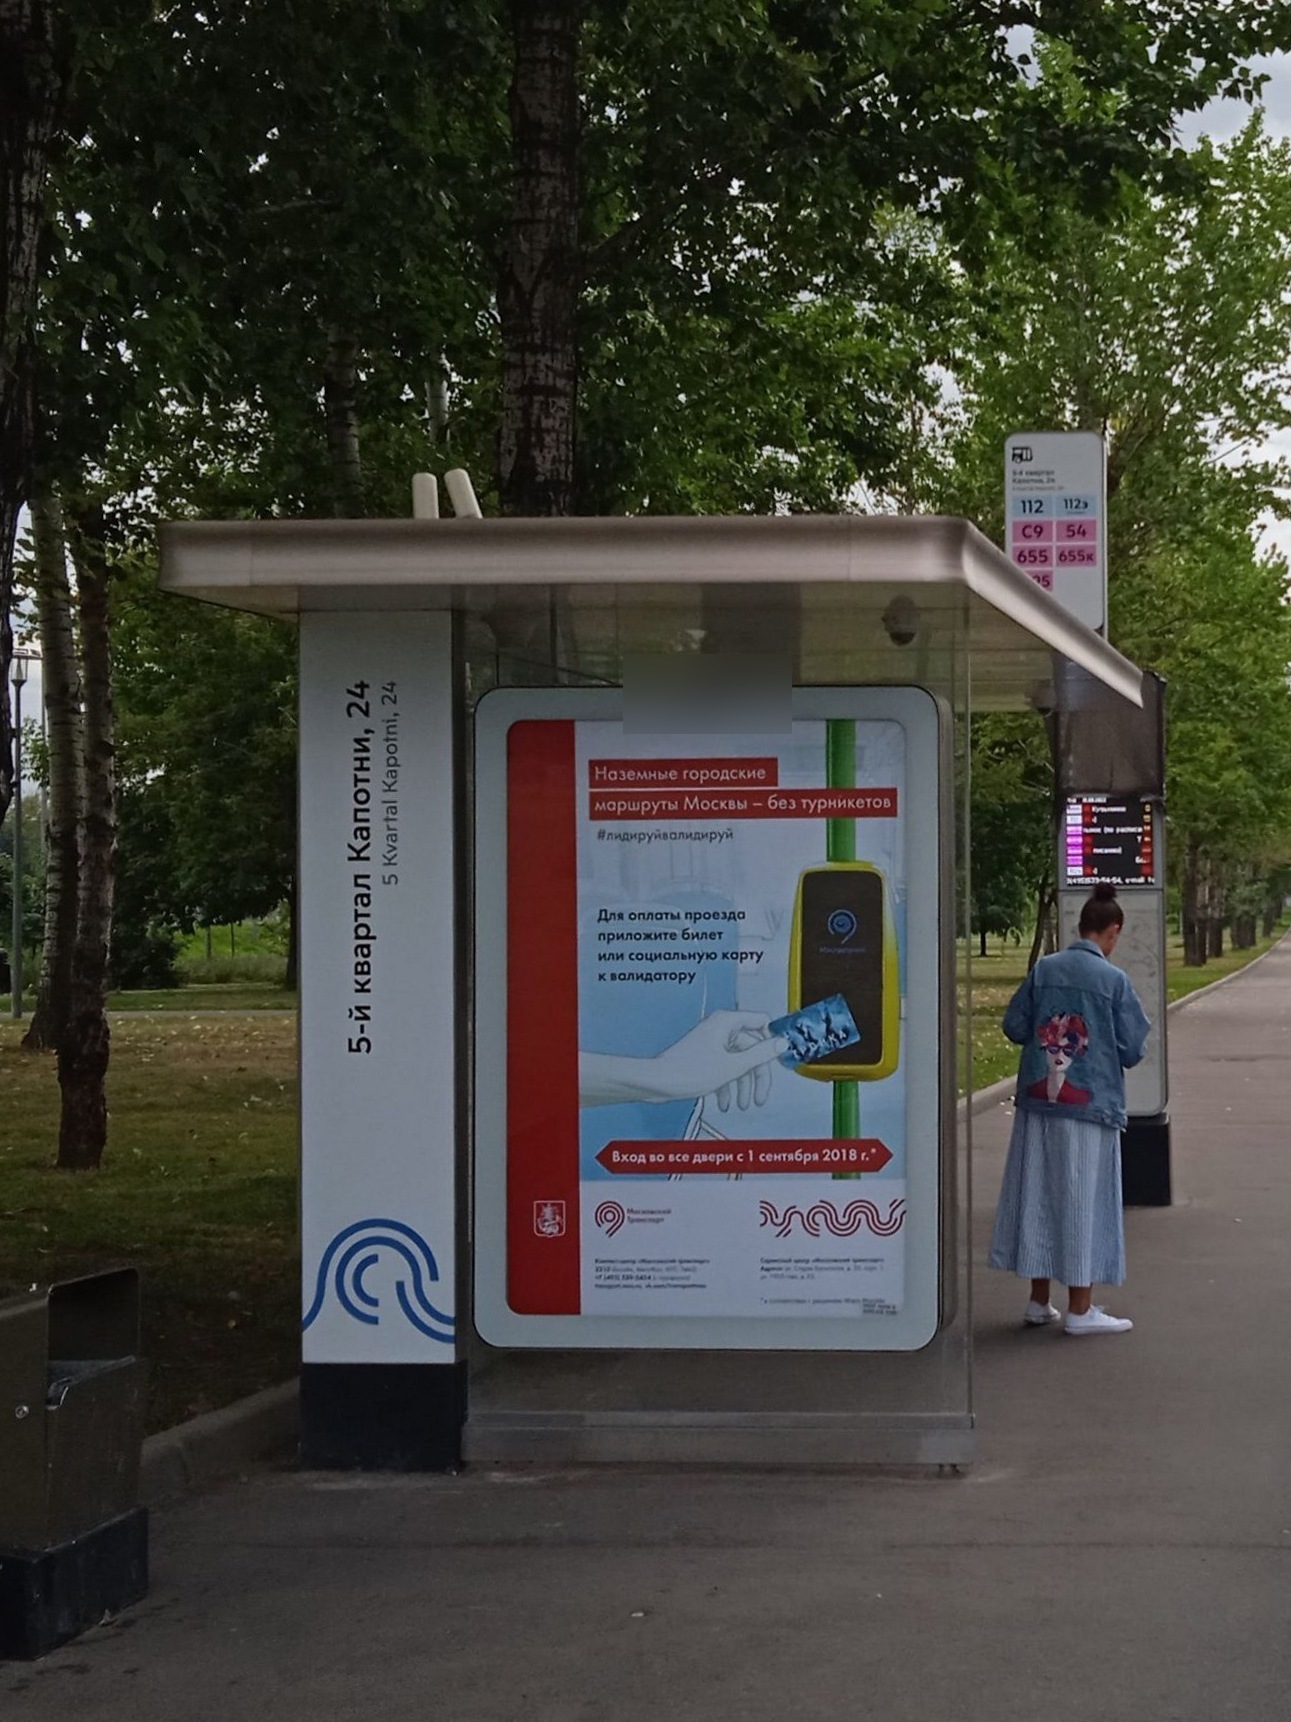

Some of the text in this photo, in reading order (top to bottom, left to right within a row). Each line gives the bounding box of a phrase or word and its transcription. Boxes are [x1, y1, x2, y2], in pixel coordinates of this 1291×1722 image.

[1021, 499, 1043, 514] 112
[1066, 524, 1087, 538] 54
[1017, 550, 1048, 563] 655
[595, 766, 766, 784] Наземные городские
[381, 681, 400, 885] 5 Kvartal Kapotni, 24
[595, 799, 678, 815] маршруты
[684, 796, 748, 811] Москвы
[767, 794, 796, 809] без
[802, 797, 891, 813] турникетов
[597, 828, 734, 843] #лидируйвалидируй
[346, 680, 377, 1054] 5-й квартал Капотни, 24
[597, 909, 746, 923] Для оплаты проезда
[598, 928, 723, 944] приложите билет
[598, 950, 763, 964] или социальную карту
[598, 972, 696, 984] к валидатору
[612, 1150, 647, 1164] Вход
[649, 1153, 665, 1162] во
[668, 1153, 690, 1162] все
[692, 1153, 734, 1165] двери
[736, 1153, 744, 1162] с
[748, 1149, 753, 1162] 1
[759, 1149, 819, 1165] сентября
[822, 1148, 857, 1161] 2018
